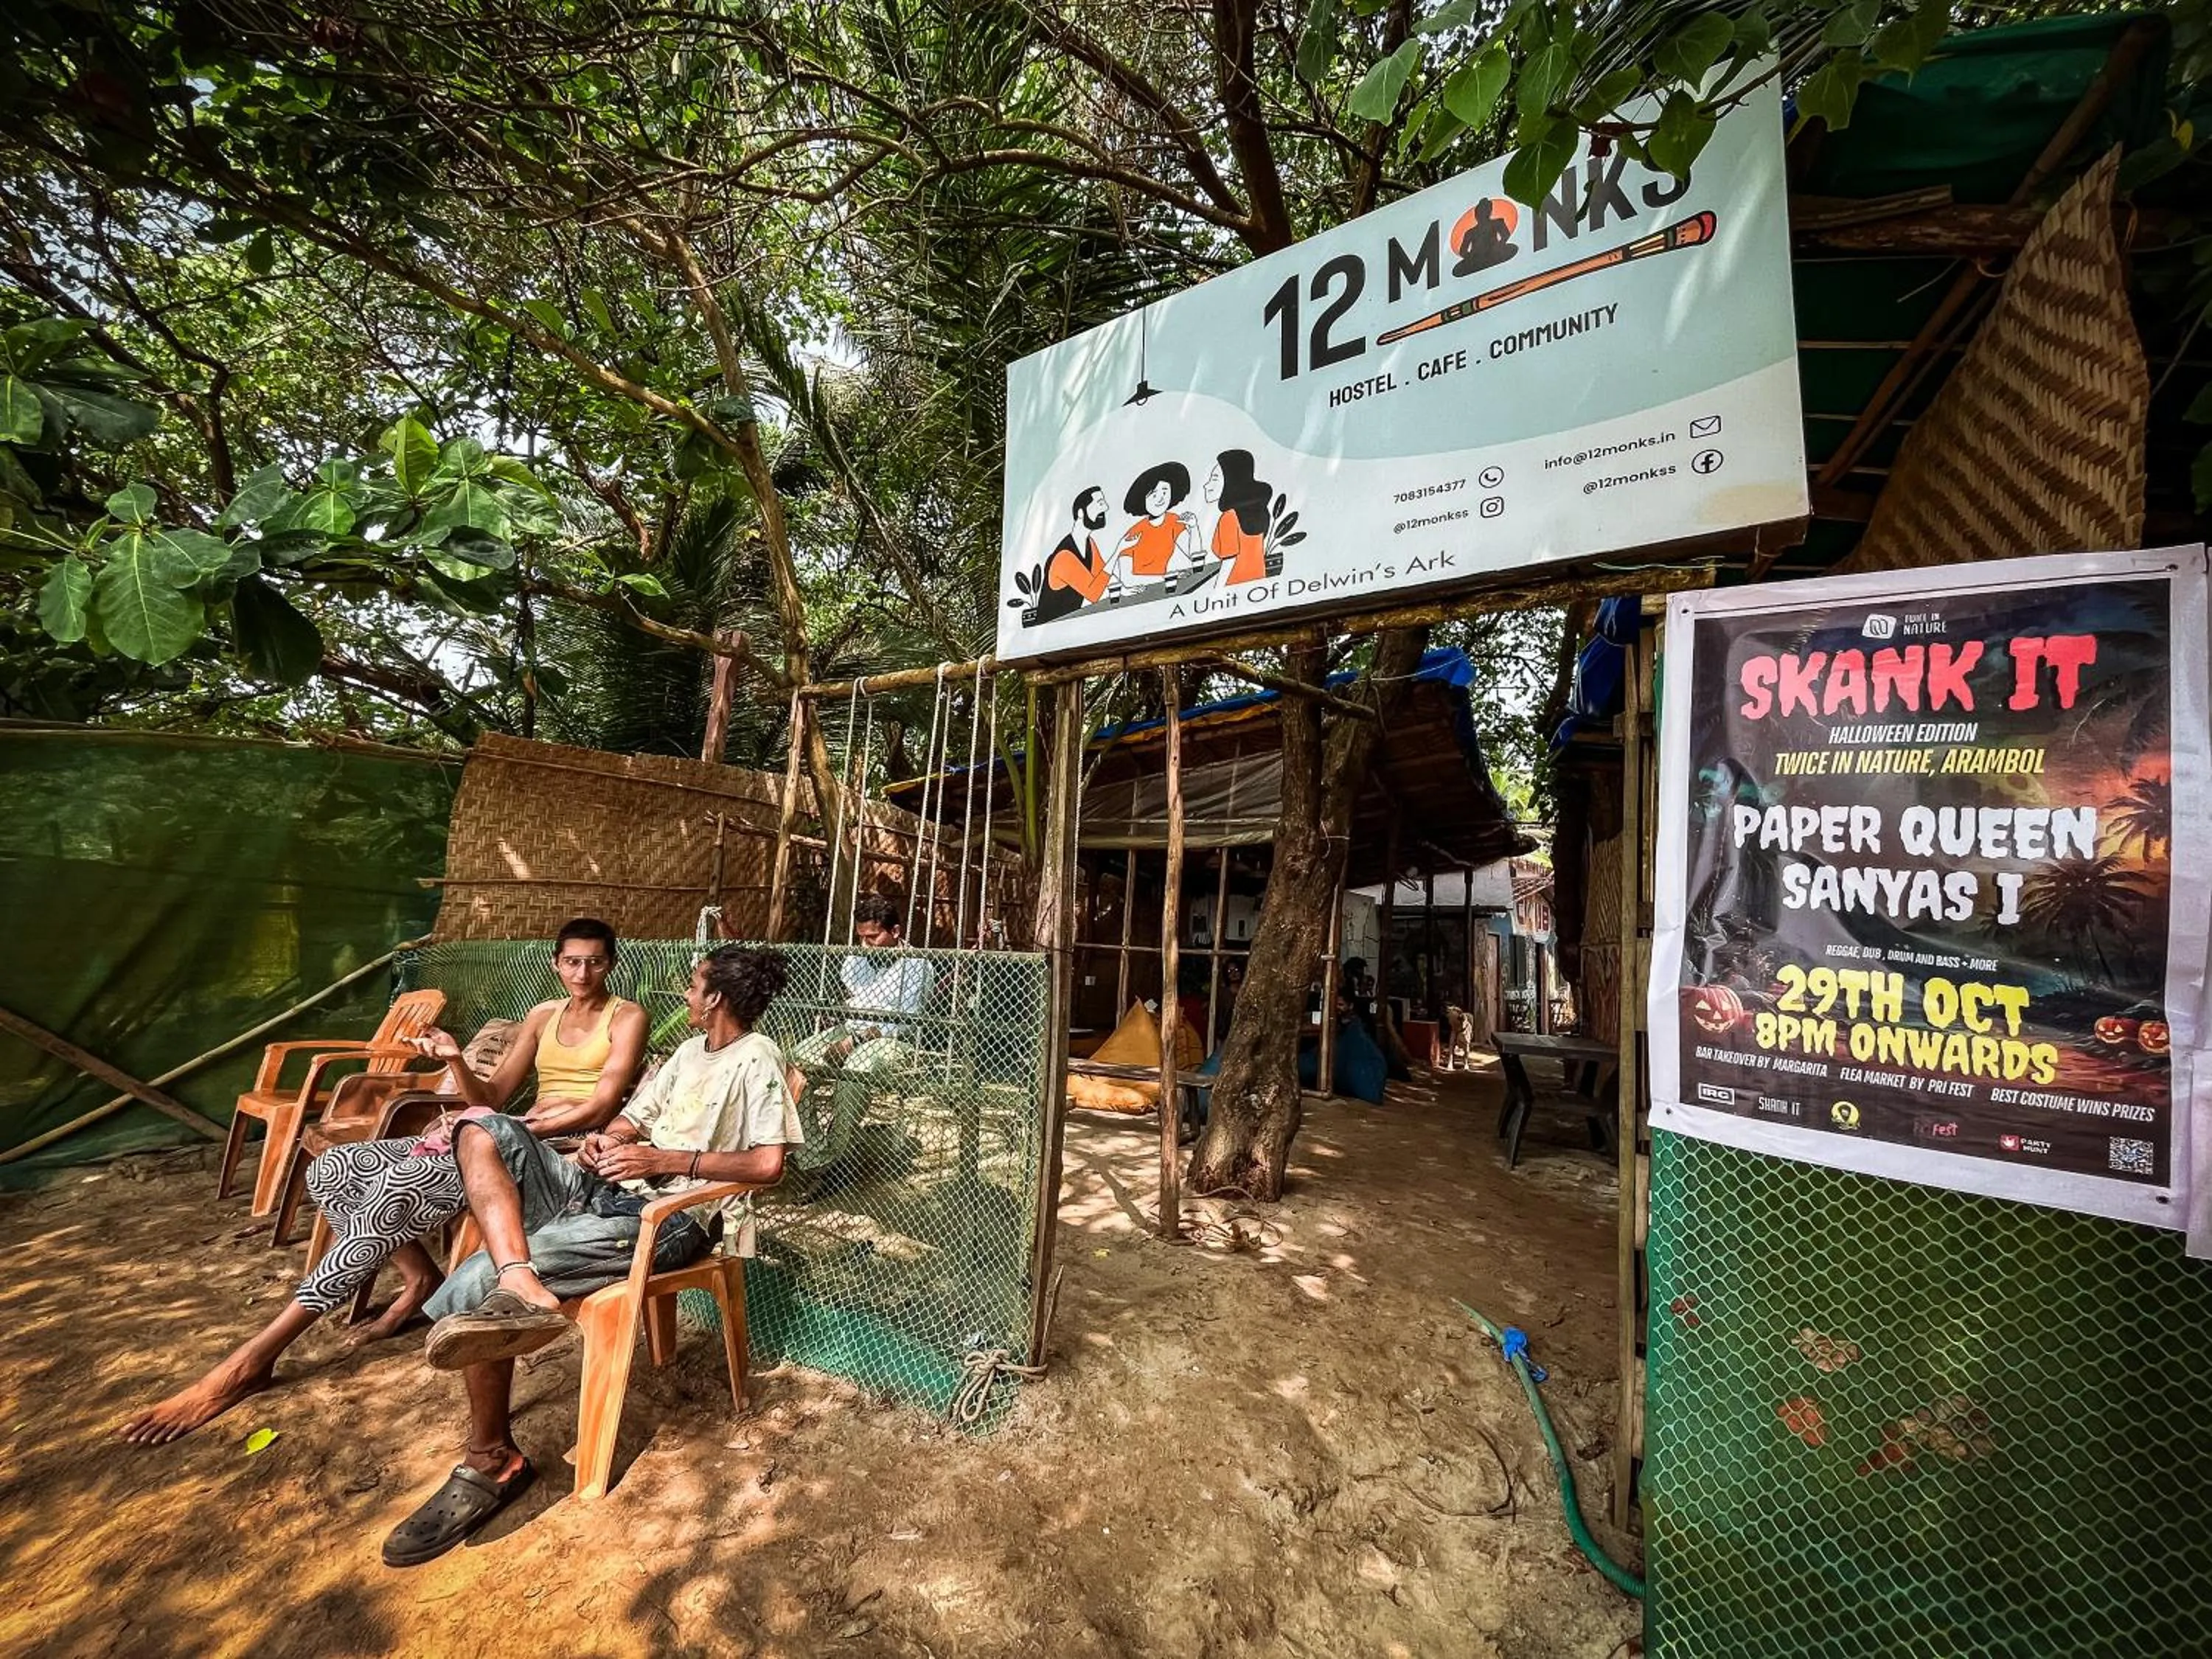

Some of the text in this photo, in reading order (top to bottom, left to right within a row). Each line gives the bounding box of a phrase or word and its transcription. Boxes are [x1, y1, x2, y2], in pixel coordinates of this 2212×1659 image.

[1264, 254, 1366, 382] 12
[1329, 375, 1397, 408] HOSTEL
[1417, 349, 1467, 381] CAFE
[1489, 303, 1619, 360] COMMUNITY
[1544, 430, 1676, 470] info@12monks.in
[1393, 479, 1467, 504] 7083154377
[1582, 463, 1677, 495] @12monkss
[1393, 507, 1469, 534] @12monkss
[1169, 549, 1455, 619] A Unit Of Delwin's Ark
[1903, 621, 1947, 635] NATURE
[1740, 633, 2098, 720] SKANK IT
[1829, 723, 1978, 744] HALLOWEEN EDITION
[1775, 748, 2045, 777] TWICE IN NATURE, ARAMBOL
[1733, 804, 2097, 860] PAPER QUEEN
[1781, 863, 2023, 925] SANYAS I
[1825, 945, 1860, 959] REGGAE,
[1888, 949, 1915, 962] DRUM
[1916, 953, 1934, 965] AND
[1935, 956, 1961, 968] BASS
[1969, 958, 1999, 972] MORE
[1775, 964, 2030, 1038] 29TH OCT
[1696, 1046, 1828, 1077] BAR TAKEOVER BY MARGARITA
[1755, 1012, 2059, 1085] 8PM ONWARDS
[1840, 1068, 1976, 1098] FLEA MARKET BY PRI FEST
[1791, 1101, 1801, 1116] IT
[1991, 1088, 2155, 1122] BEST COSTUME WINS PRIZES
